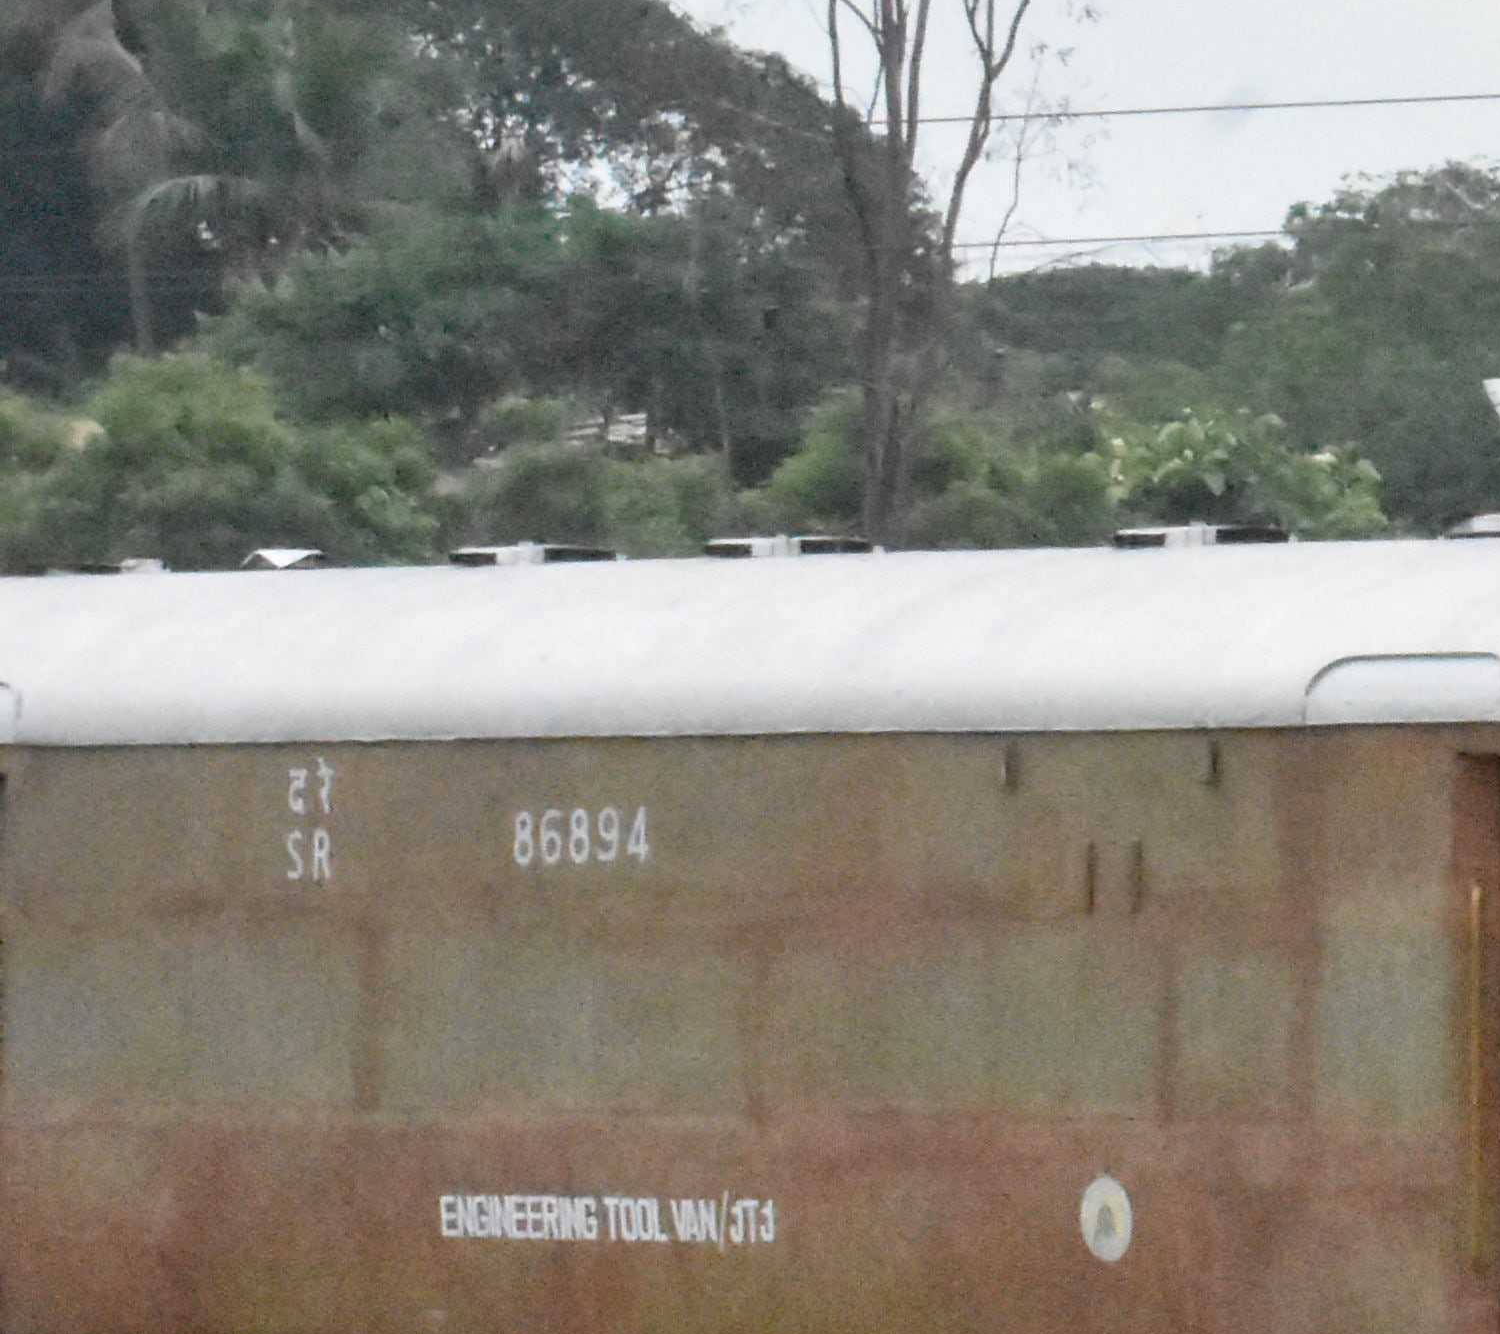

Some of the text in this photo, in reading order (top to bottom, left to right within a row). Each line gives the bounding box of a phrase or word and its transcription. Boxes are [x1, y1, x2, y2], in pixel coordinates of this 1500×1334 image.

[286, 828, 331, 880] SR
[513, 805, 649, 865] 86894
[439, 1194, 598, 1241] ENGINEERING
[603, 1196, 668, 1243] TOOL
